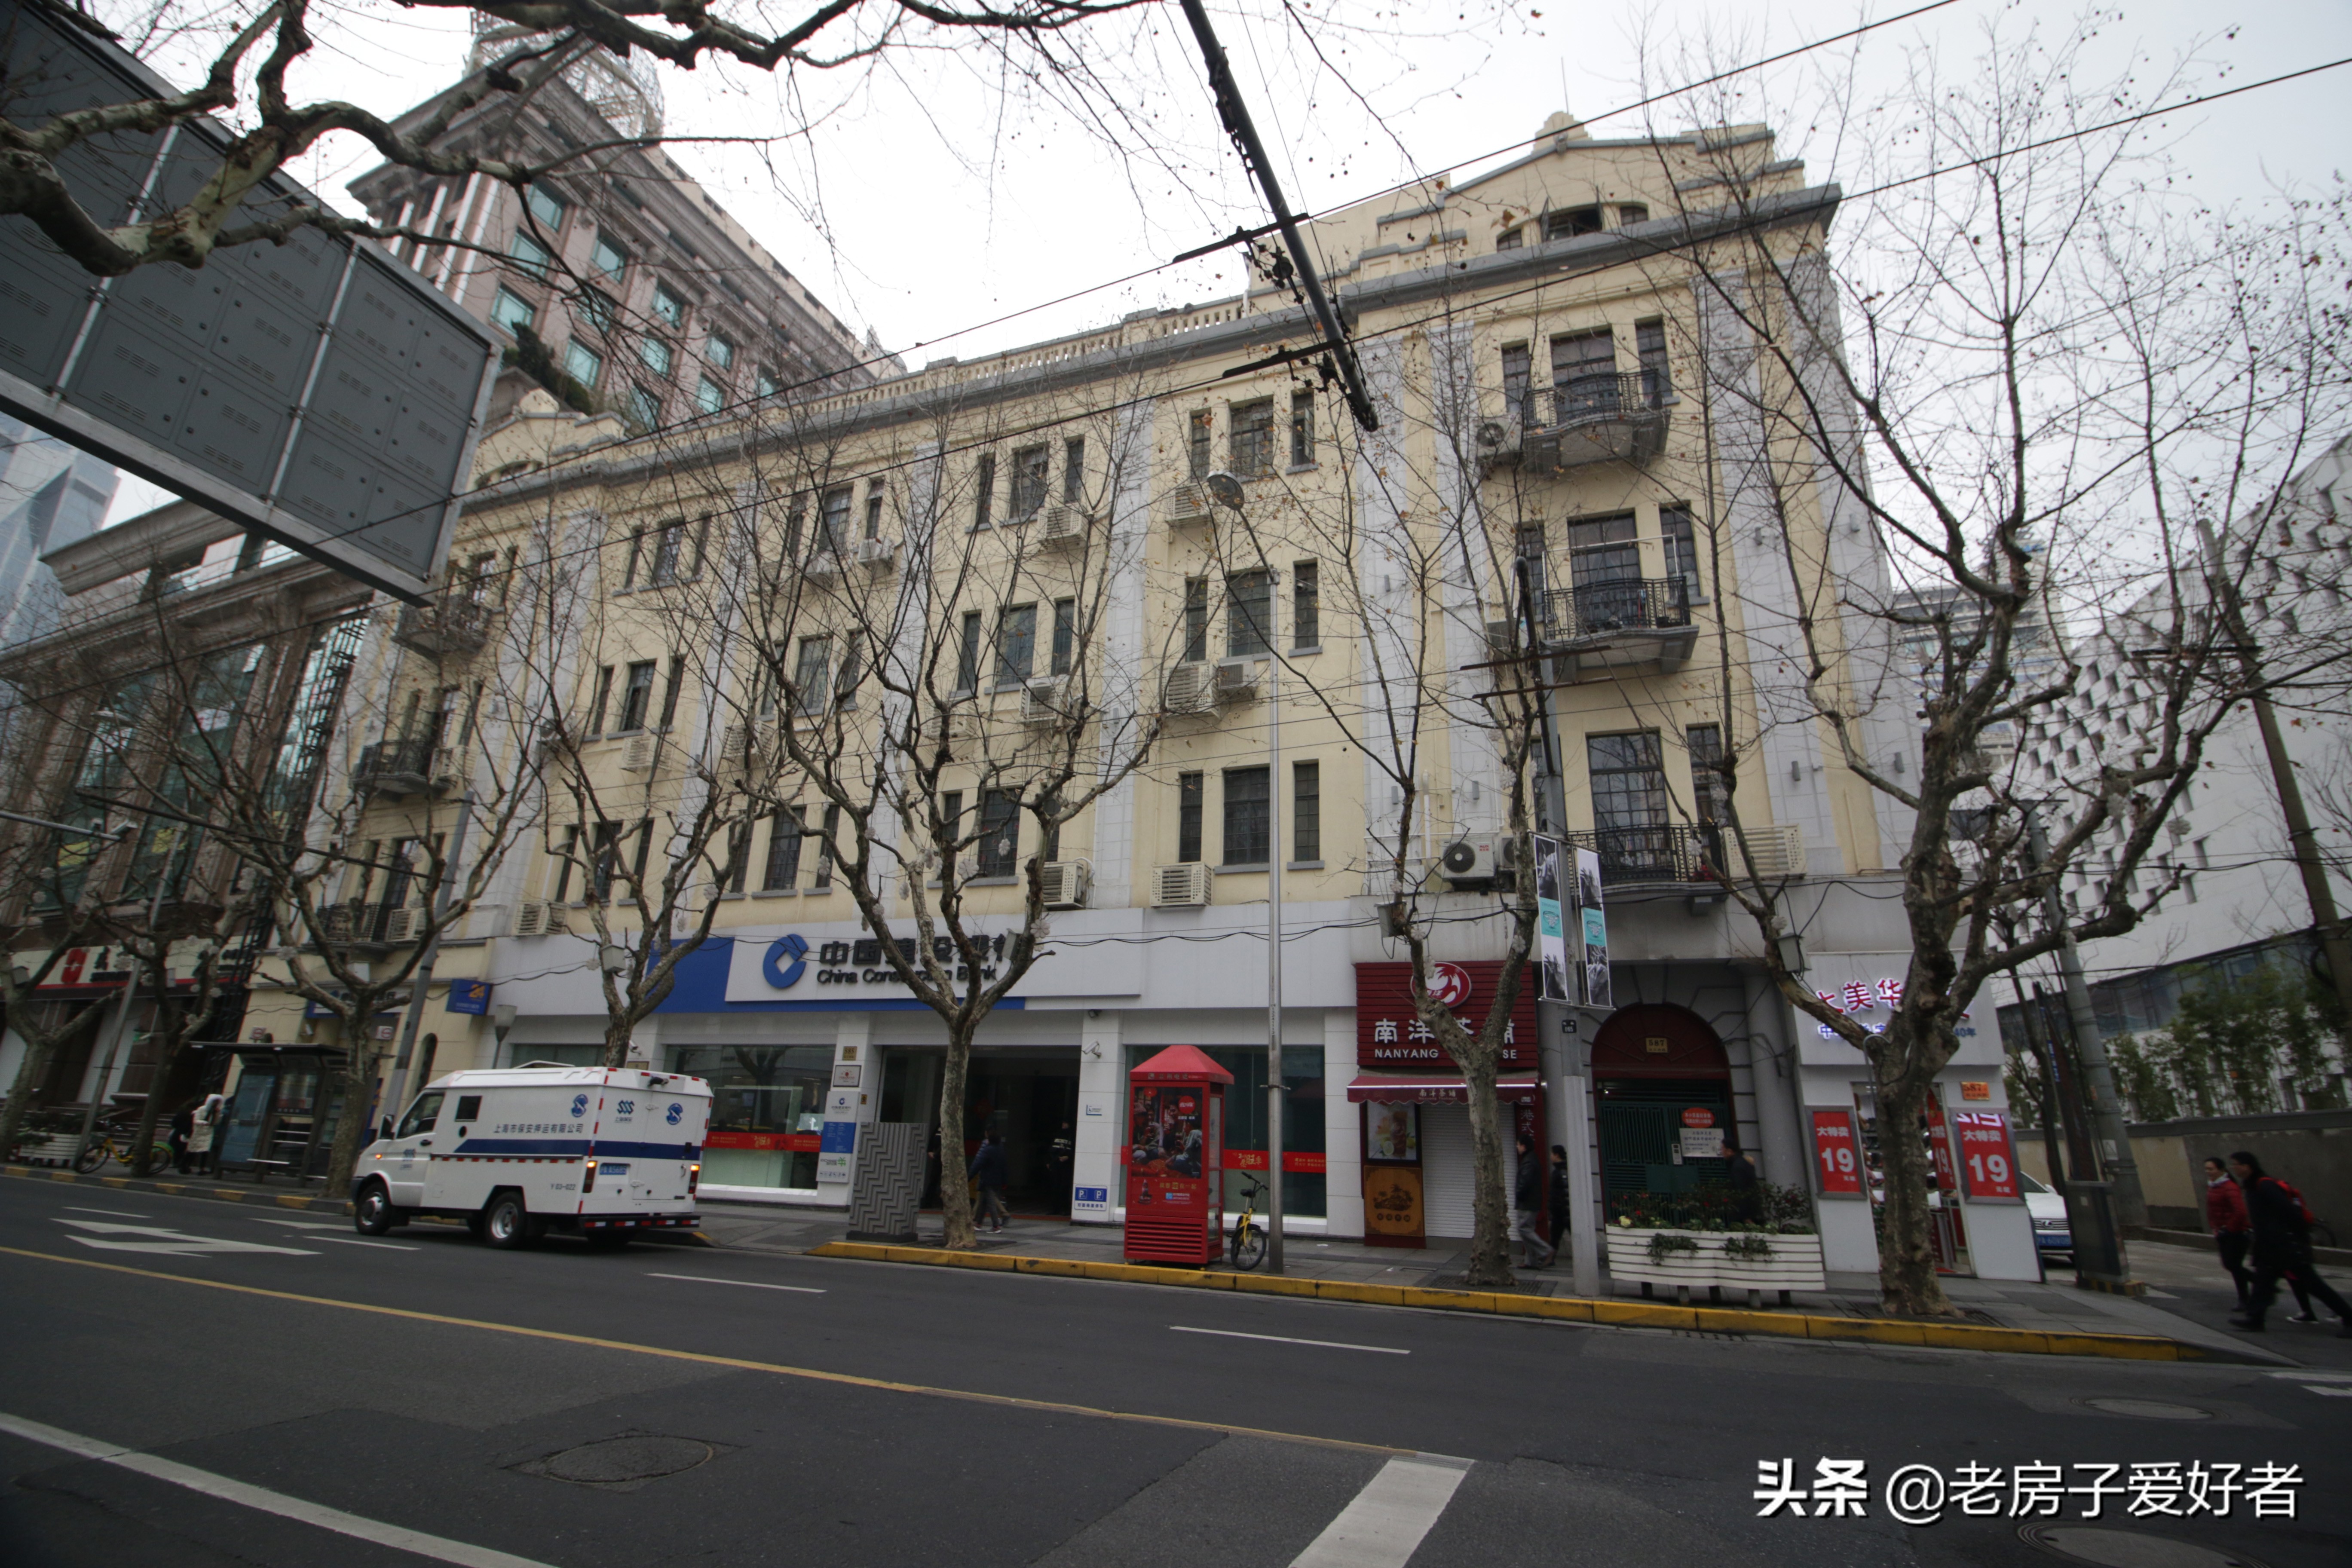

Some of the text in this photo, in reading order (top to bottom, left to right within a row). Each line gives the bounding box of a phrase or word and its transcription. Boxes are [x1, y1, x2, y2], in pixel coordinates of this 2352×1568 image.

[817, 969, 858, 983] China
[957, 965, 996, 980] Bnk
[469, 984, 485, 998] 24
[1375, 1049, 1439, 1058] NANYANG
[493, 1124, 583, 1133] 上海市保安押运有限公司
[1817, 1126, 1850, 1136] 大特卖
[1963, 1130, 2002, 1142] 大特卖
[1821, 1147, 1855, 1173] 19
[1969, 1154, 2009, 1182] 19
